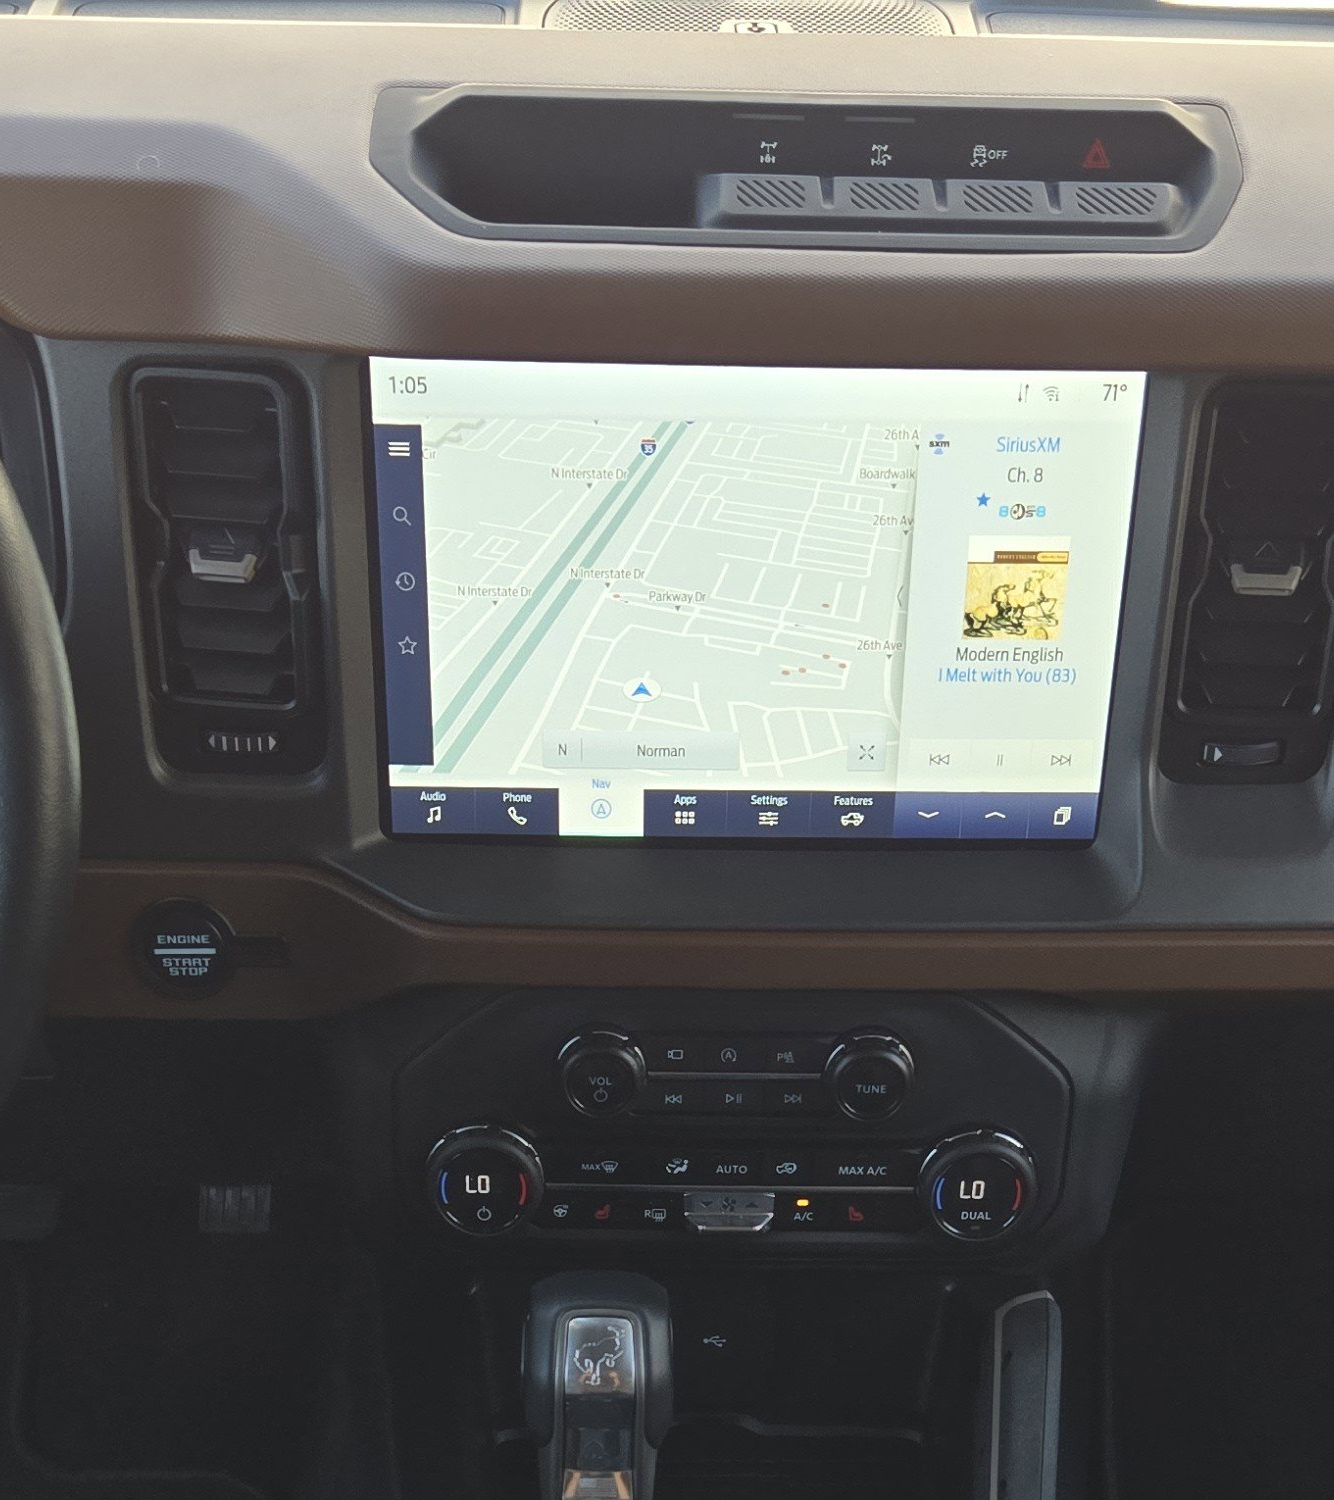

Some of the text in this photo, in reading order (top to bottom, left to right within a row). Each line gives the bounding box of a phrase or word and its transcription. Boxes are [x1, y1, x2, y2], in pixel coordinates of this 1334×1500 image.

[987, 150, 1009, 160] OFF
[388, 376, 427, 395] 1:05
[884, 429, 910, 440] 26th
[996, 437, 1060, 453] SiriusXM
[551, 468, 627, 480] N Interstate Dr
[859, 468, 915, 479] Boardwalk
[1007, 467, 1043, 483] Ch. 8
[872, 515, 897, 526] 26th
[570, 568, 645, 579] N Interstate Dr
[457, 586, 532, 597] N Interstate Dr
[649, 591, 706, 604] Parkway Dr
[857, 640, 903, 651] 26th Ave
[956, 647, 1063, 664] Modern English
[946, 668, 977, 682] Melt
[981, 668, 1012, 682] with
[1016, 669, 1042, 682] You
[1046, 668, 1077, 685] (83)
[558, 744, 567, 756] N
[637, 745, 685, 758] Norman
[592, 778, 611, 789] Nav
[420, 791, 446, 802] Audio
[503, 792, 532, 803] Phone
[674, 794, 697, 807] Apps
[750, 795, 788, 807] Settings
[834, 796, 873, 807] Features
[157, 934, 210, 944] ENGINE
[162, 957, 211, 967] START
[169, 966, 208, 976] STOP
[588, 1076, 612, 1086] VOL
[855, 1084, 887, 1095] TUNE
[581, 1163, 601, 1171] MAX
[716, 1164, 748, 1174] AUTO
[838, 1165, 887, 1177] MAX A/C
[959, 1180, 986, 1200] LO
[793, 1211, 814, 1222] A/C
[960, 1210, 991, 1221] DUAL
